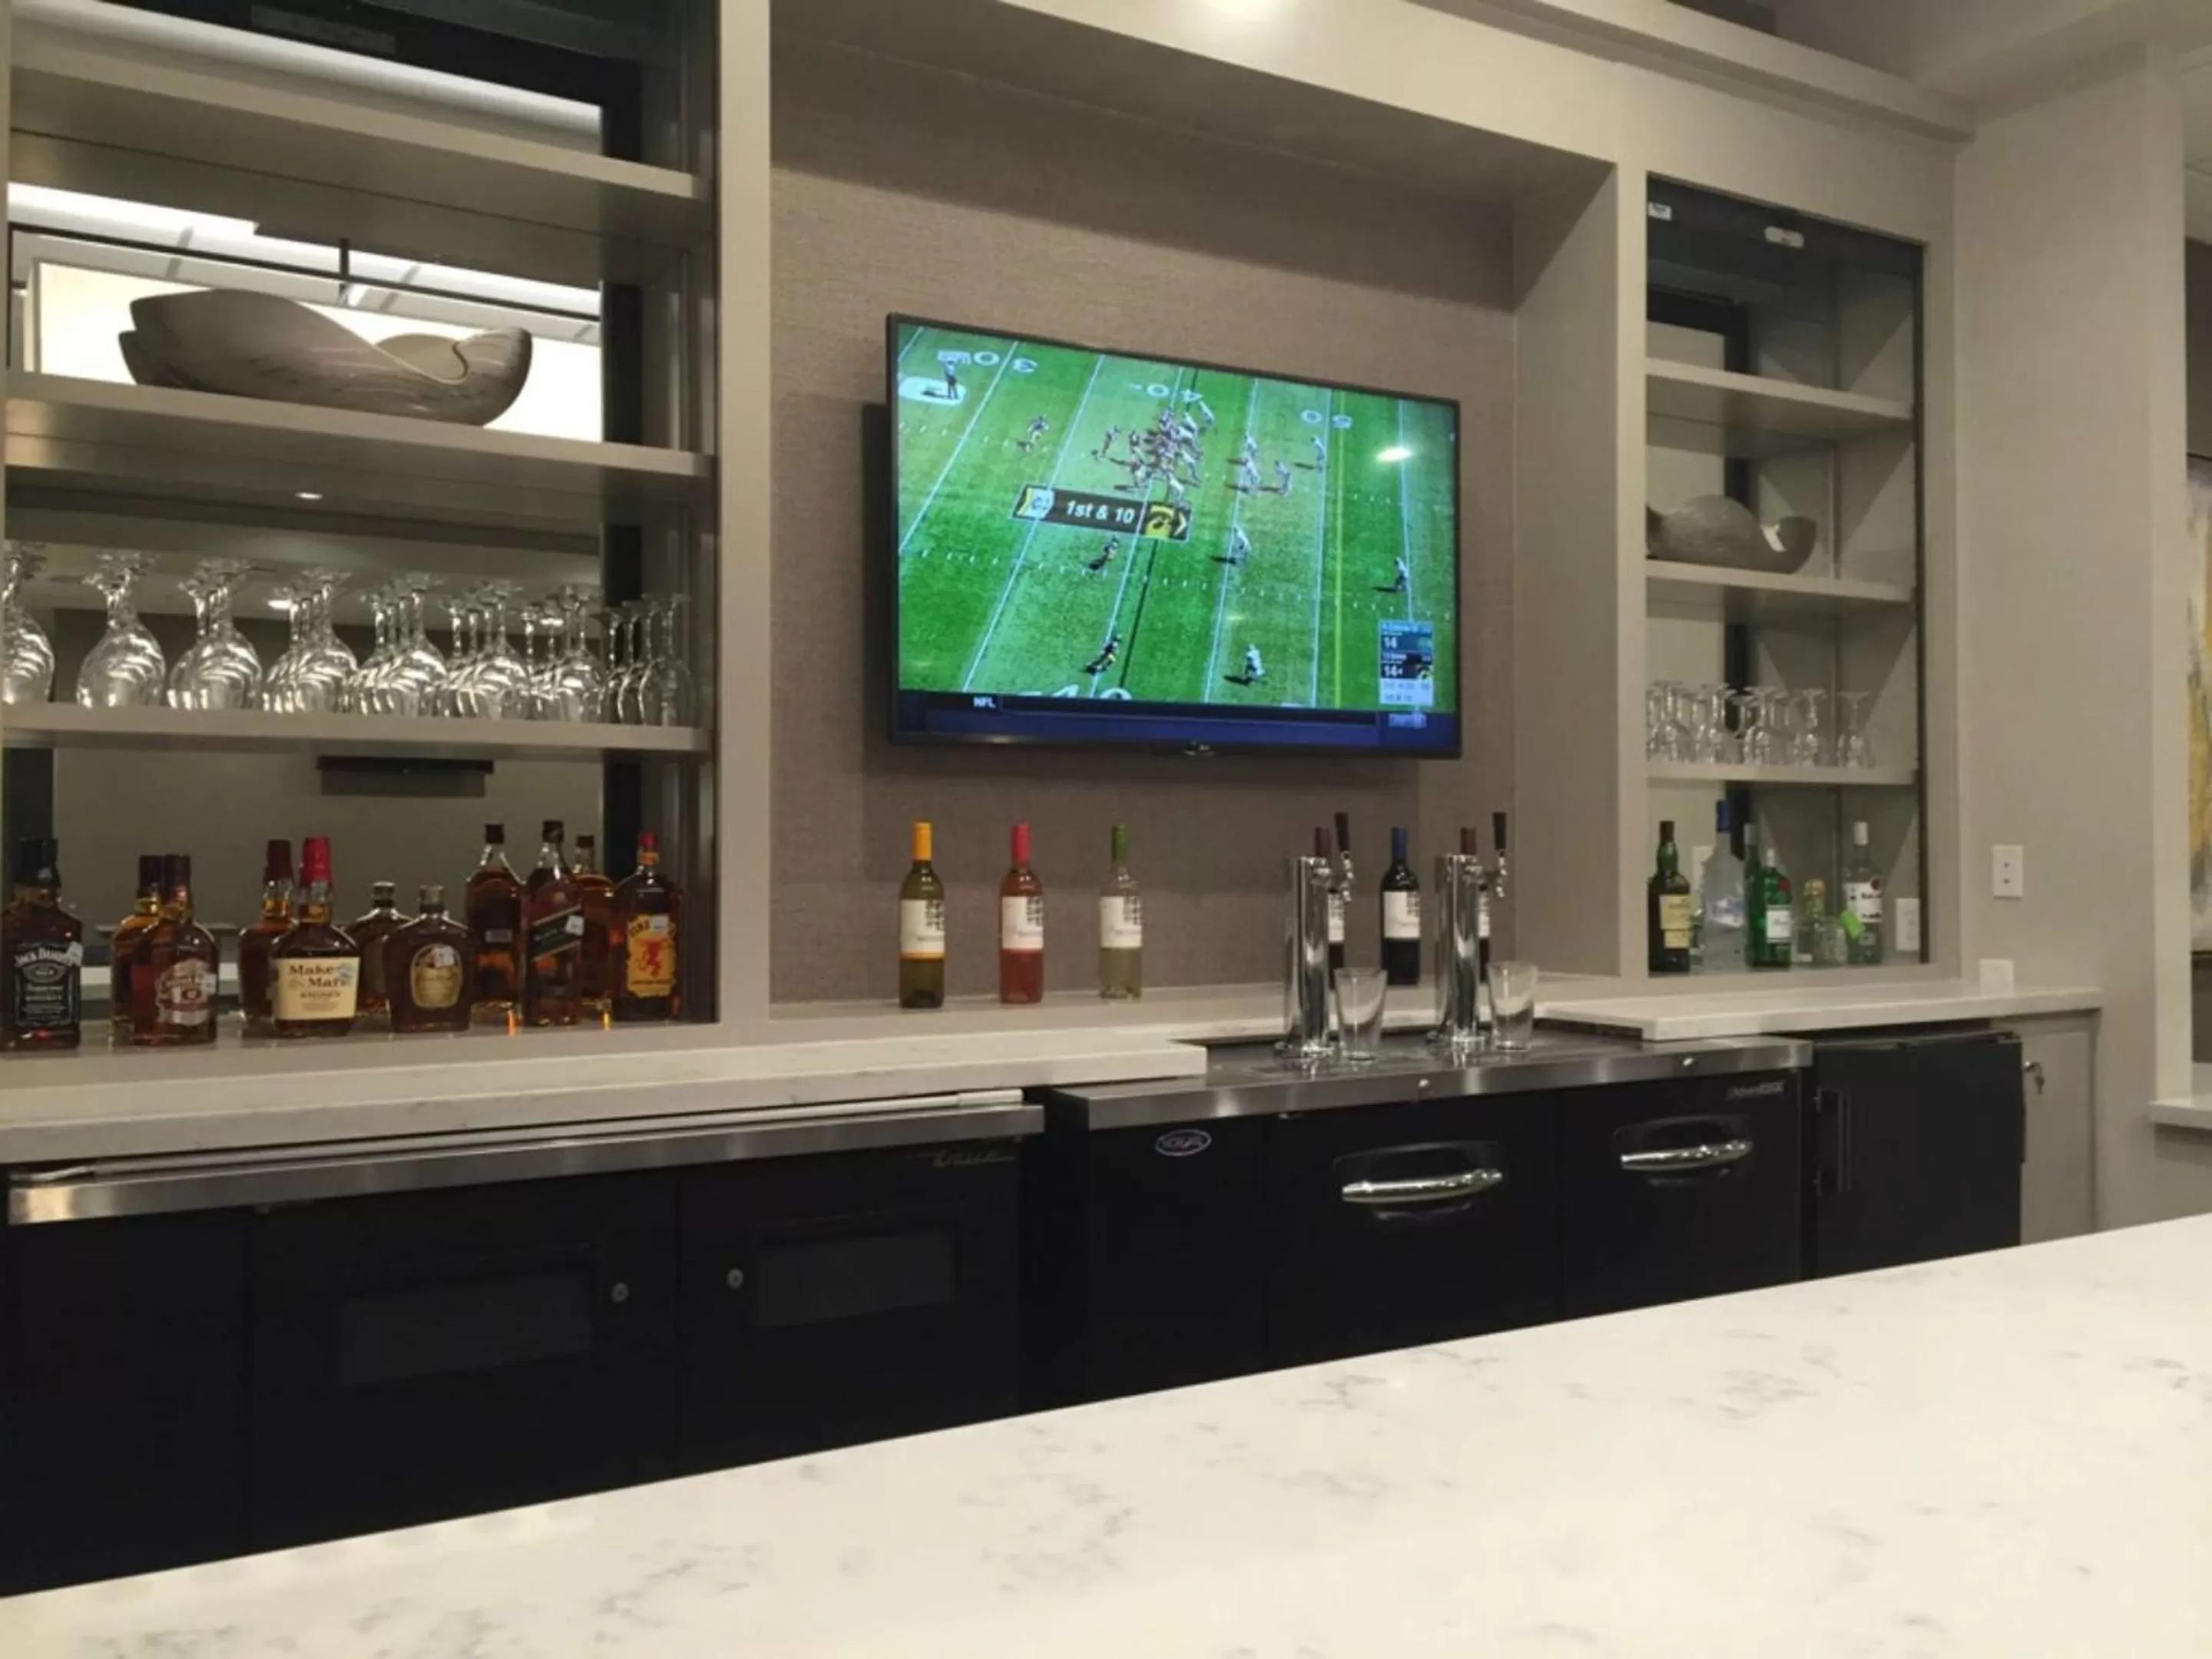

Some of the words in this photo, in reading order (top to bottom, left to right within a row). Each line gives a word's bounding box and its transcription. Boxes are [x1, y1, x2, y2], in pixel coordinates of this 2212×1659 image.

[1065, 499, 1093, 518] 1st
[1095, 505, 1108, 520] &
[1114, 506, 1135, 523] 10
[972, 696, 996, 709] NFL
